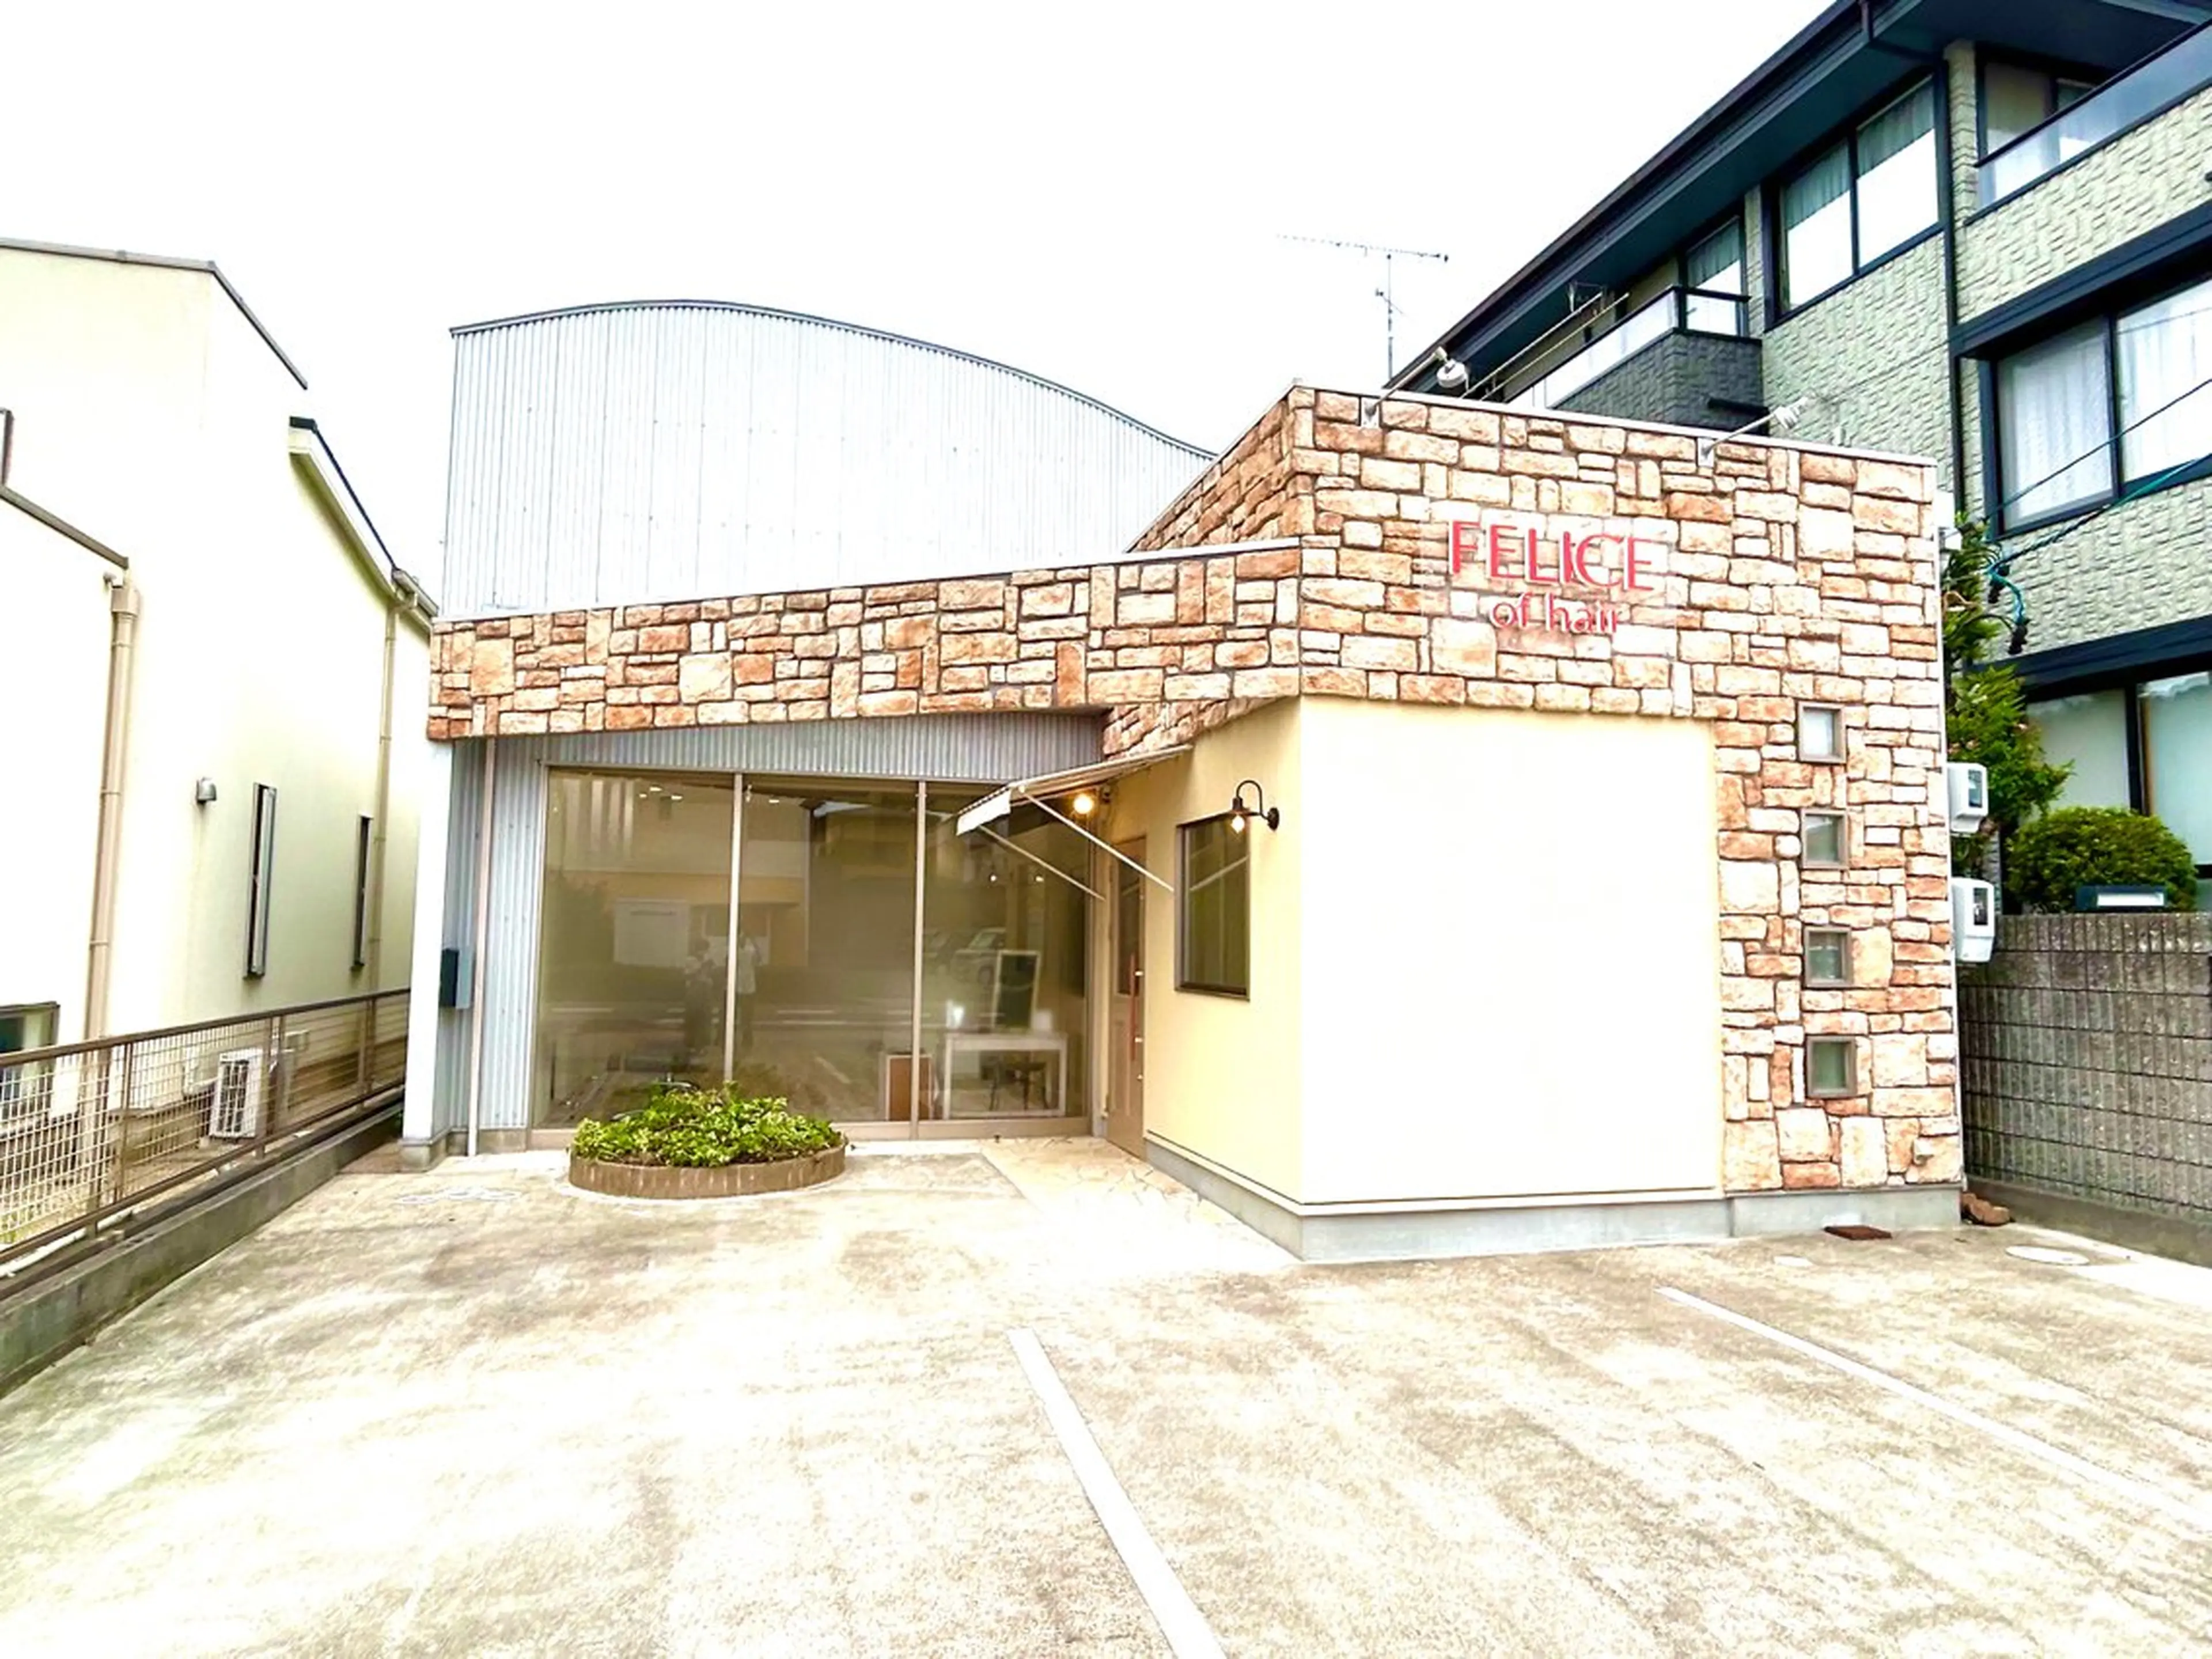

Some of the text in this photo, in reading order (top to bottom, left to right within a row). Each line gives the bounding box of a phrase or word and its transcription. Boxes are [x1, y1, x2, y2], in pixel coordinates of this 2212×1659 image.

[1451, 520, 1655, 591] FELICE
[1492, 592, 1622, 633] of hair
